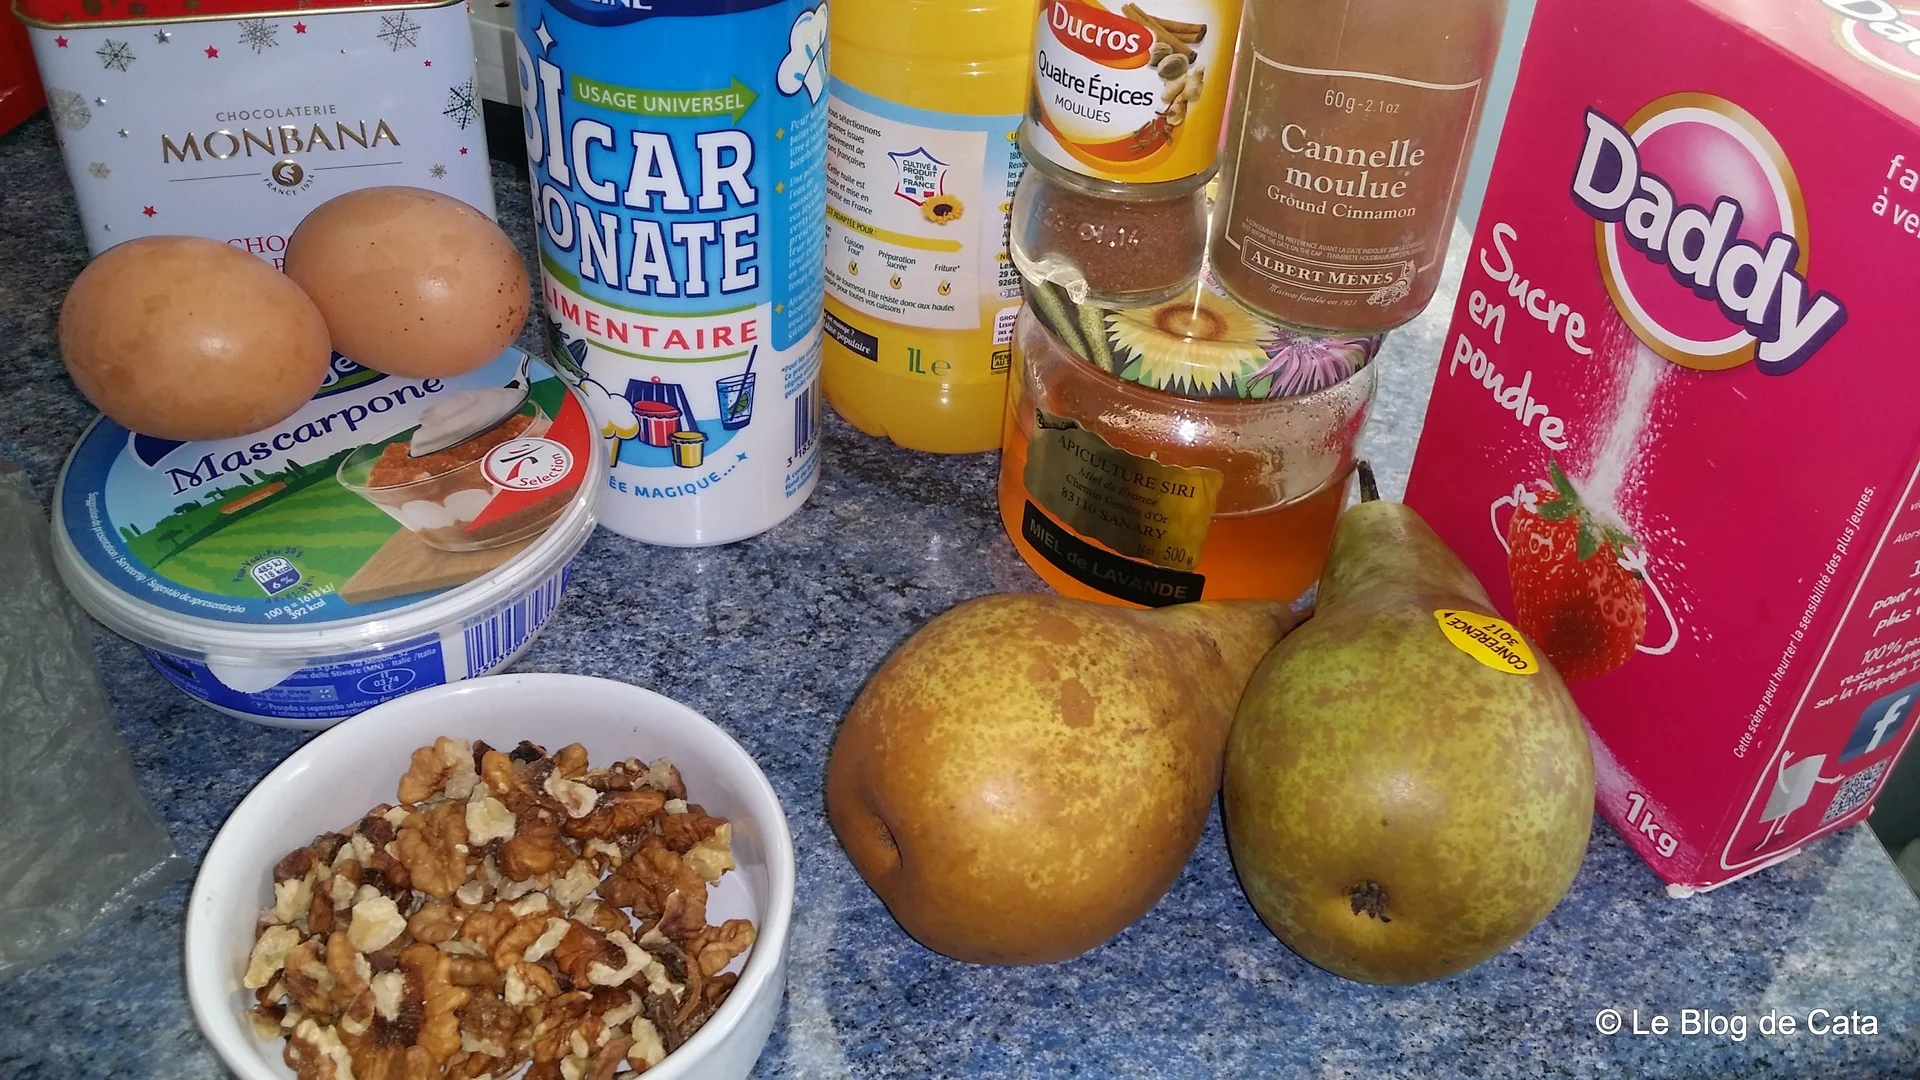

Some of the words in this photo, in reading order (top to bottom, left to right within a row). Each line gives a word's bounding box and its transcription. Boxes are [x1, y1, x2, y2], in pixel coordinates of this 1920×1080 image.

[1052, 3, 1141, 54] Ducros
[1038, 49, 1085, 94] Quatre
[1088, 74, 1154, 106] Épices
[579, 83, 637, 110] USAGE
[643, 94, 745, 113] UNIVERSEL
[1054, 94, 1112, 124] MOULUES
[216, 104, 338, 122] CHOCOLATERIE
[839, 113, 882, 138] sélectionnons
[161, 117, 401, 164] MONBANA
[1281, 124, 1425, 167] Cannelle
[836, 148, 866, 169] françaises
[902, 159, 932, 171] CULTIVÉ
[902, 166, 938, 178] PRODUIT
[840, 171, 856, 183] huile
[855, 179, 866, 190] est
[846, 187, 861, 198] mise
[860, 193, 870, 203] en
[902, 177, 936, 190] FRANCE
[1285, 165, 1408, 199] moulue
[843, 196, 852, 206] en
[851, 200, 873, 217] France
[1267, 184, 1327, 216] Ground
[1332, 203, 1416, 221] Cinnamon
[844, 236, 865, 251] Cuisson
[857, 223, 874, 236] POUR
[1571, 107, 1846, 374] Daddy
[847, 246, 861, 257] Four
[878, 250, 917, 265] Préparation
[886, 260, 908, 271] sucrée
[1250, 250, 1325, 284] ALBERT
[1268, 283, 1298, 300] Maison
[1296, 292, 1326, 306] fondée
[1480, 222, 1592, 356] Sucre
[865, 298, 876, 307] vos
[875, 301, 902, 314] cuissons
[899, 299, 917, 309] donc
[917, 302, 930, 310] aux
[931, 302, 955, 312] hautes
[1468, 290, 1506, 345] en
[907, 347, 926, 375] 1L
[1448, 333, 1569, 451] poudre
[164, 378, 444, 496] Mascarpone
[519, 452, 564, 487] Selection
[1057, 434, 1157, 491] APICULTURE
[1160, 480, 1196, 499] SIRI
[1078, 467, 1102, 486] Miel
[1103, 480, 1117, 491] de
[1066, 473, 1101, 500] Chemin
[1144, 505, 1169, 524] d'Or
[1061, 486, 1097, 515] 83110
[1099, 508, 1168, 541] SANARY
[258, 563, 273, 574] 485
[1030, 518, 1063, 557] MIEL
[1066, 551, 1088, 570] de
[1092, 562, 1189, 600] LAVANDE
[1163, 546, 1186, 563] 500
[1187, 556, 1194, 566] g
[259, 570, 276, 582] 118
[274, 563, 292, 575] kcal
[147, 576, 181, 598] Sugestão
[188, 596, 246, 614] apresentação
[264, 607, 283, 620] 100
[283, 606, 293, 615] g
[297, 589, 321, 604] 1618
[288, 607, 308, 620] 392
[306, 597, 327, 612] kcal
[1869, 587, 1913, 618] pour
[1482, 623, 1519, 647] 3017
[1733, 730, 1753, 759] Cette
[1748, 703, 1768, 734] scène
[1761, 679, 1779, 708] peut
[1772, 640, 1798, 682] heurter
[1790, 629, 1804, 642] la
[1799, 573, 1831, 631] sensibilité
[1824, 552, 1842, 575] des
[1836, 526, 1855, 556] plus
[1846, 485, 1877, 531] jeunes.
[1872, 608, 1912, 637] plus
[1446, 617, 1528, 670] CONFERENCE
[363, 663, 385, 674] (MN)
[1840, 664, 1883, 686] restez
[1814, 696, 1839, 709] sur
[1838, 686, 1852, 702] la
[1855, 669, 1908, 695] Fanpage
[1626, 791, 1679, 858] 1kg
